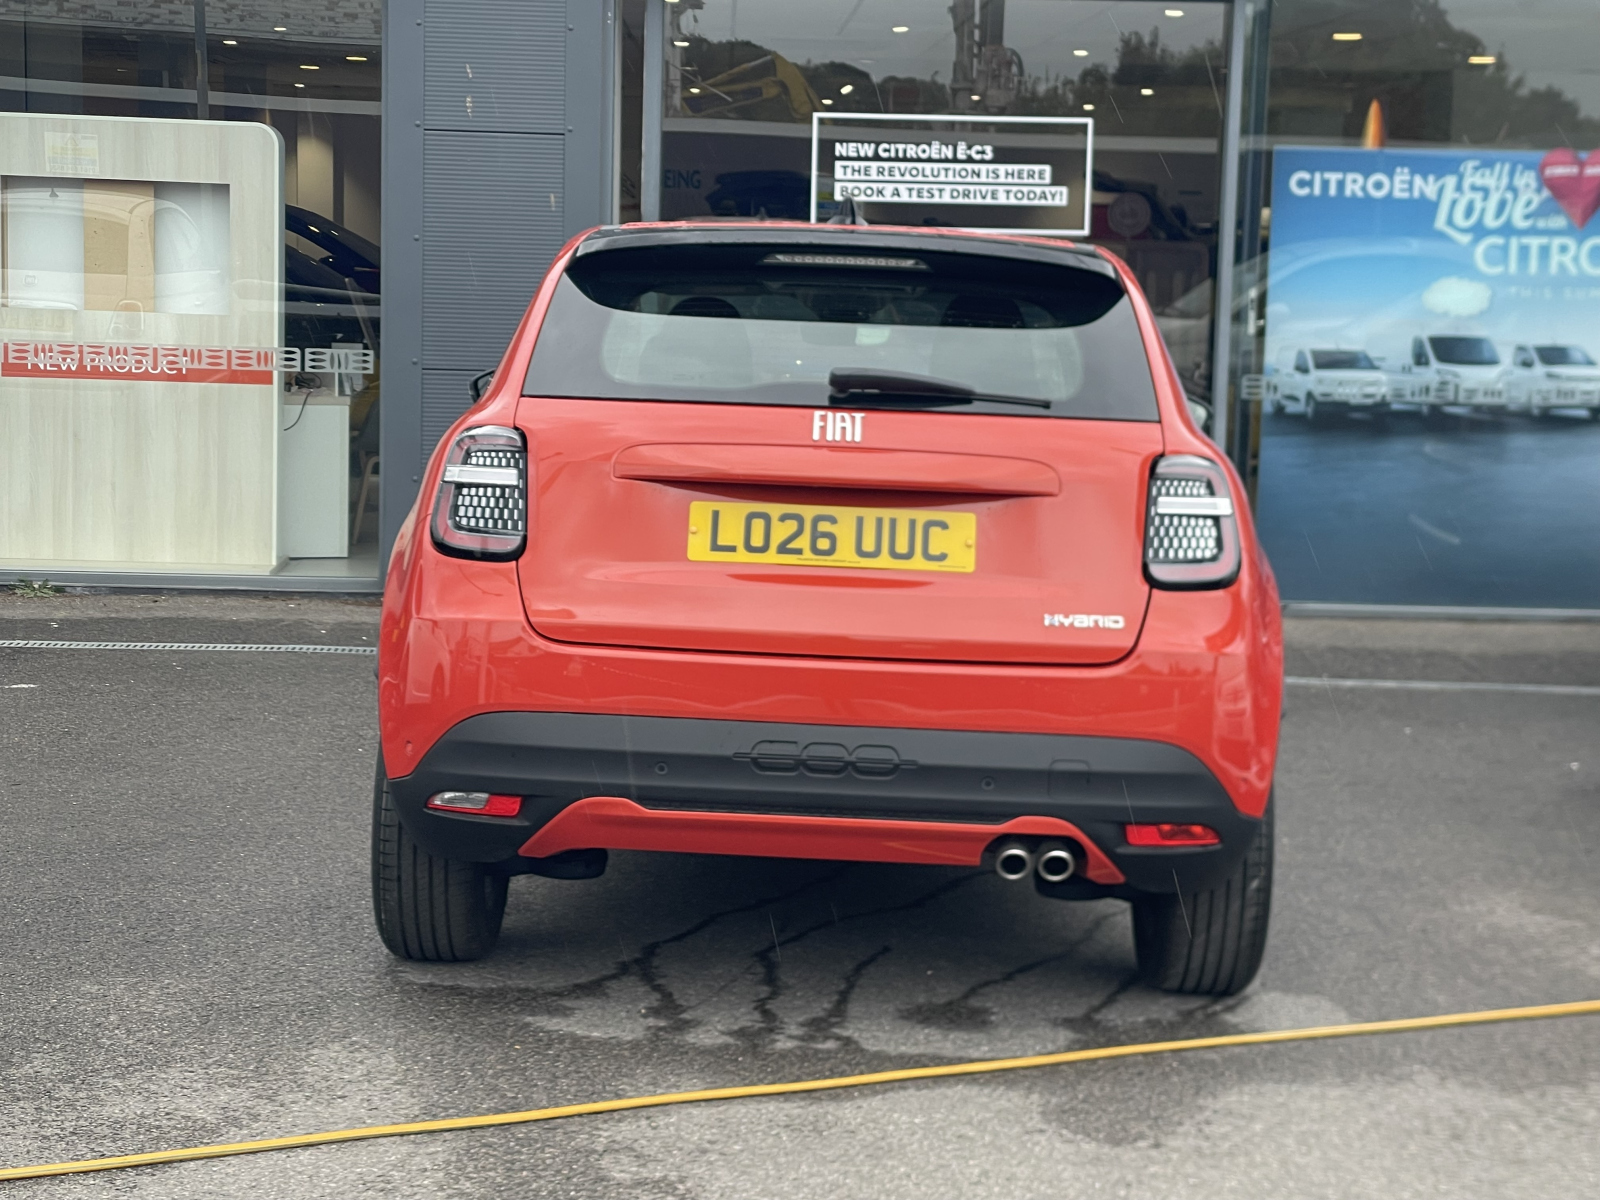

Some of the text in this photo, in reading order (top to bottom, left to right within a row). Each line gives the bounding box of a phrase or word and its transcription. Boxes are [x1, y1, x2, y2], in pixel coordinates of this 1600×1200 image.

[834, 142, 875, 158] NEW
[877, 140, 954, 160] CITROËN
[840, 165, 1047, 181] THE REVOLUTION IS HERE
[1288, 166, 1436, 202] CITROËN
[840, 185, 1065, 203] BOOK A TEST DRIVE TODAY!
[1433, 174, 1541, 245] Love
[812, 410, 865, 442] FIAT
[709, 509, 950, 562] LO26 UUC
